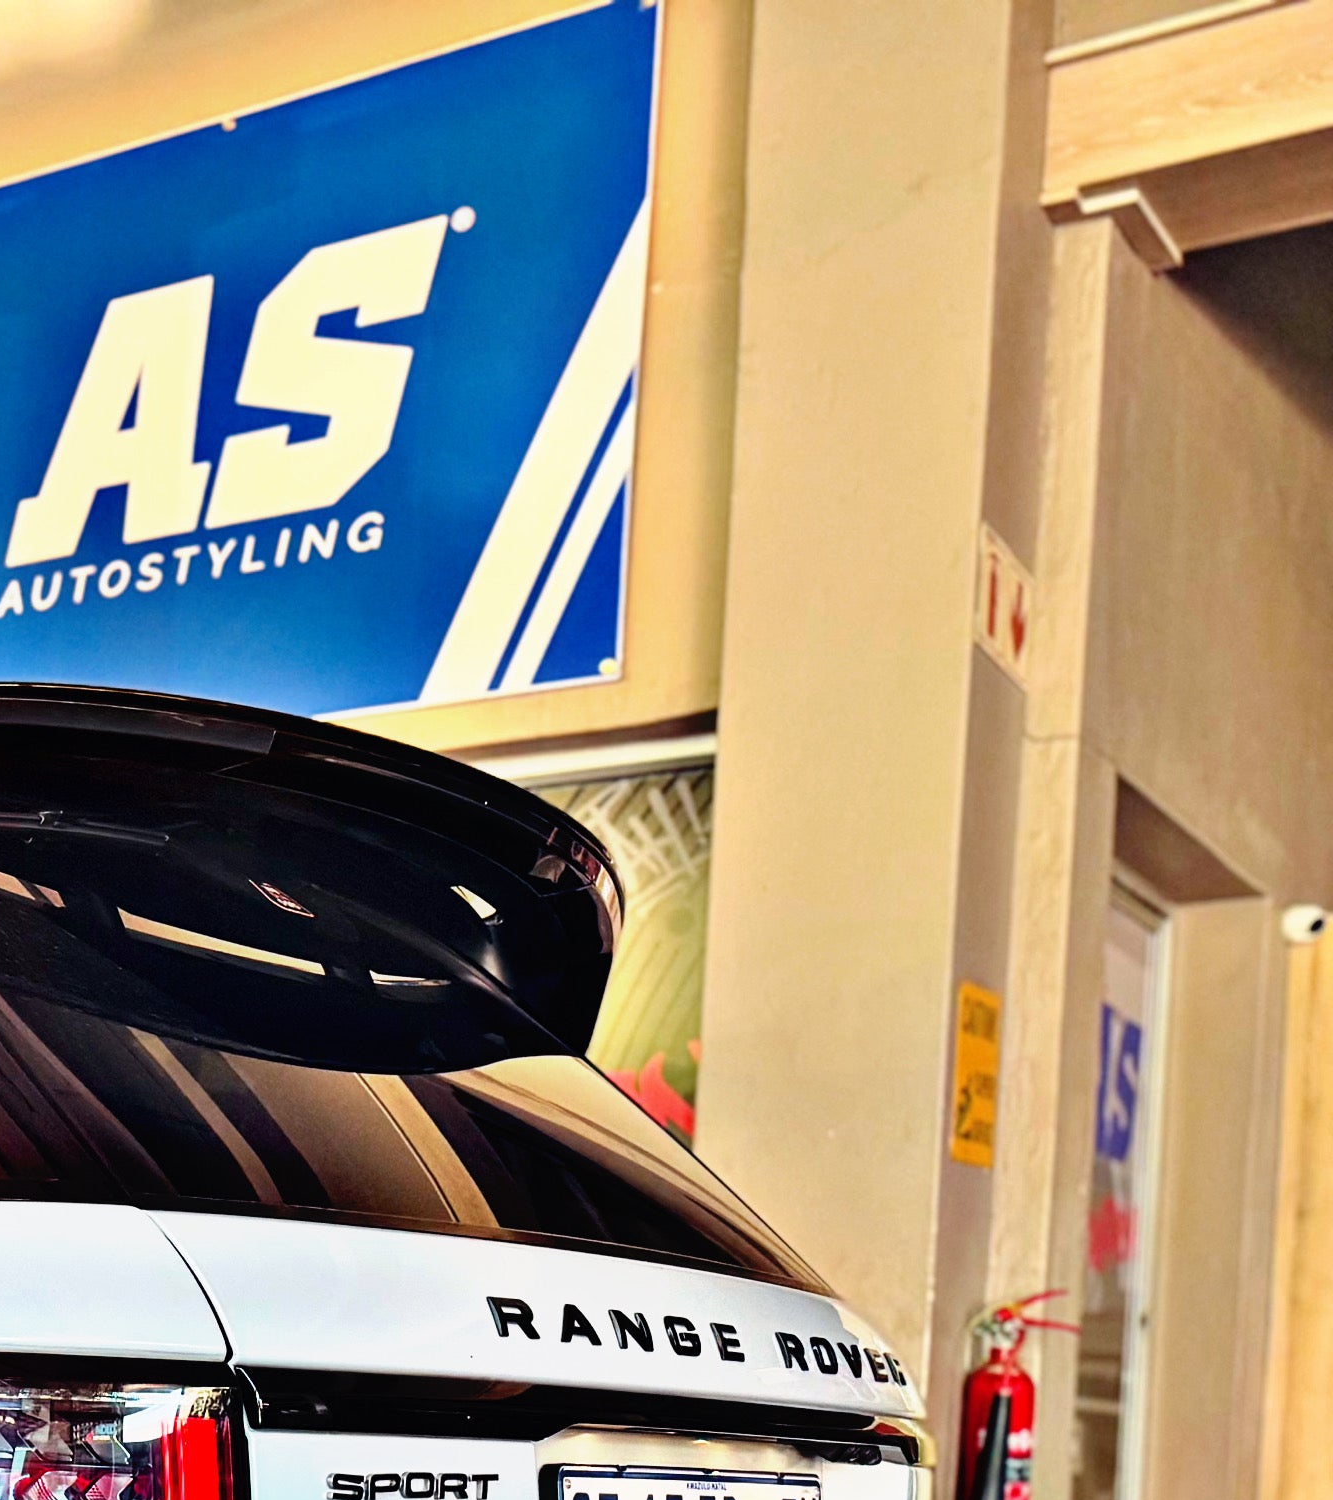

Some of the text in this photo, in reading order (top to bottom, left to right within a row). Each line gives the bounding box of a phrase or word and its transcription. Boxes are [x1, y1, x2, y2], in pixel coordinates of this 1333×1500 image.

[4, 214, 449, 568] AS
[486, 1296, 745, 1363] RANGE
[326, 1472, 499, 1500] SPORT
